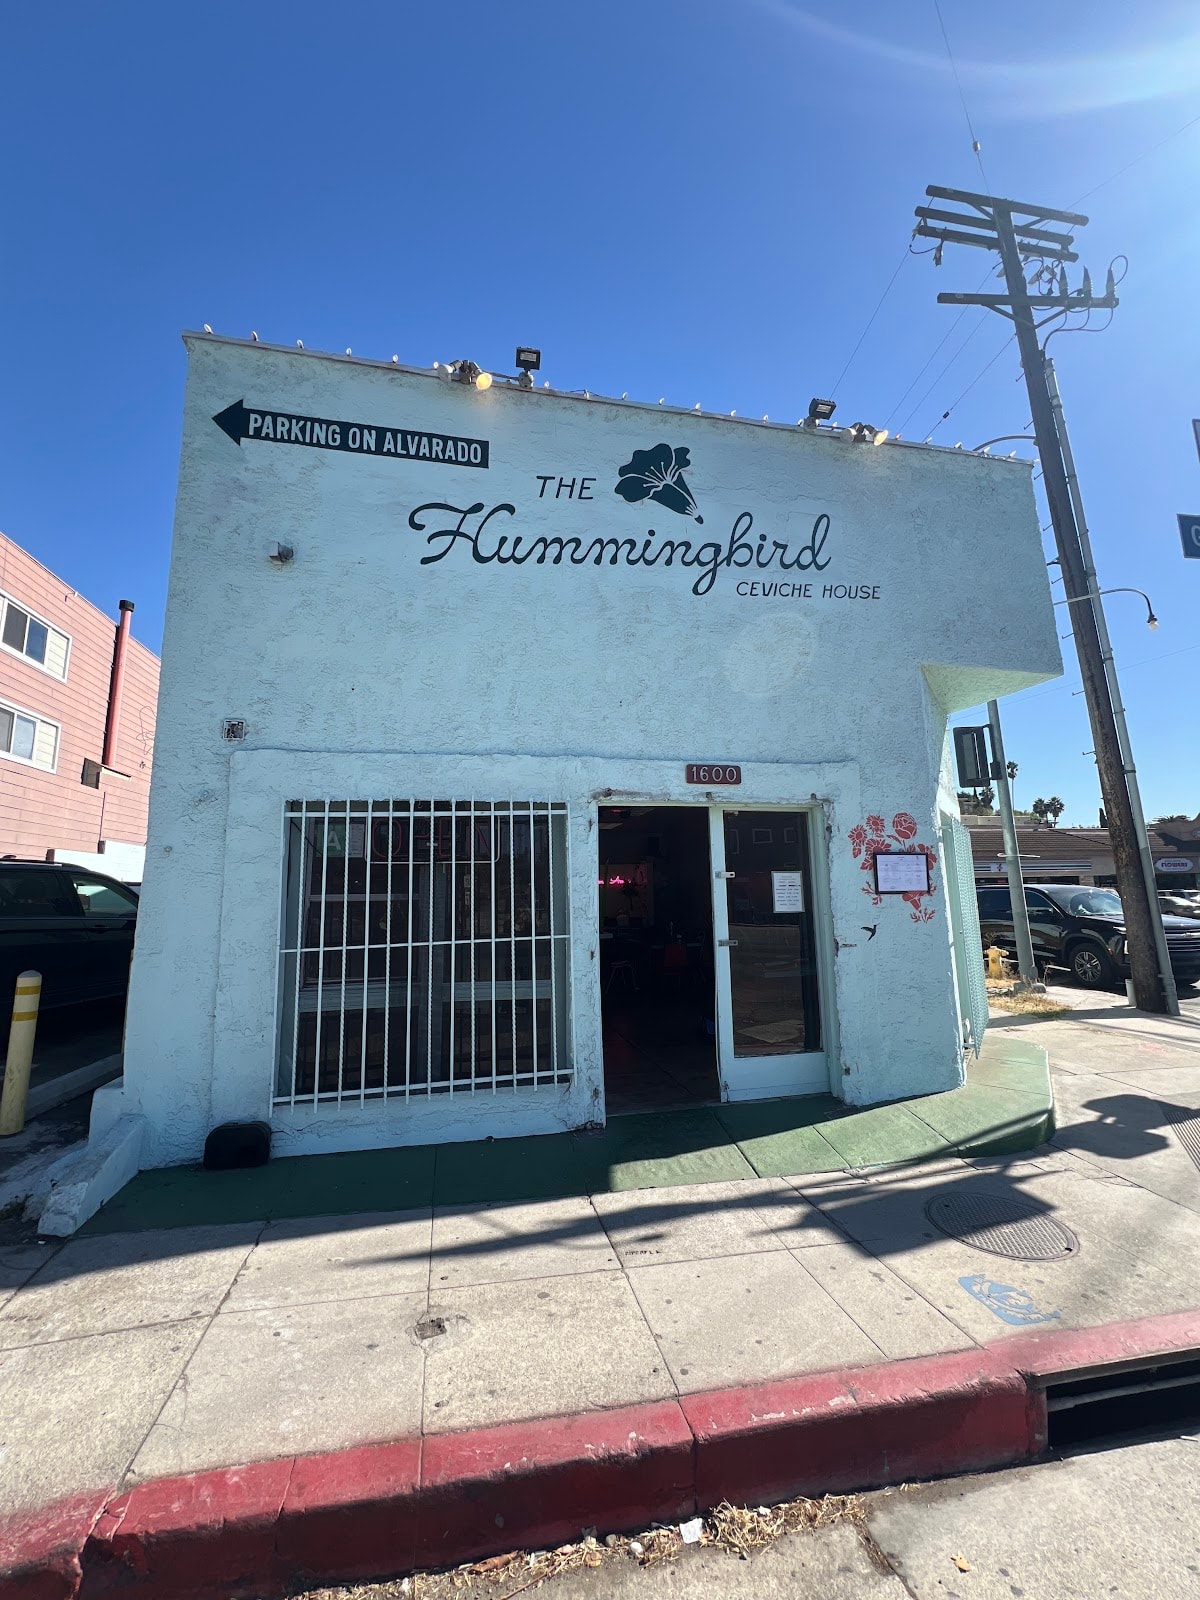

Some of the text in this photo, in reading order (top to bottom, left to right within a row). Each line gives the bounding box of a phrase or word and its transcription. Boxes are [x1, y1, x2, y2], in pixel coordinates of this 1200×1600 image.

[248, 413, 482, 464] PARKING ON ALVARADO
[535, 475, 597, 501] THE
[408, 502, 832, 596] Hummingbird
[736, 581, 881, 600] CEVICHE HOUSE
[691, 766, 737, 782] 1600
[326, 830, 342, 850] A
